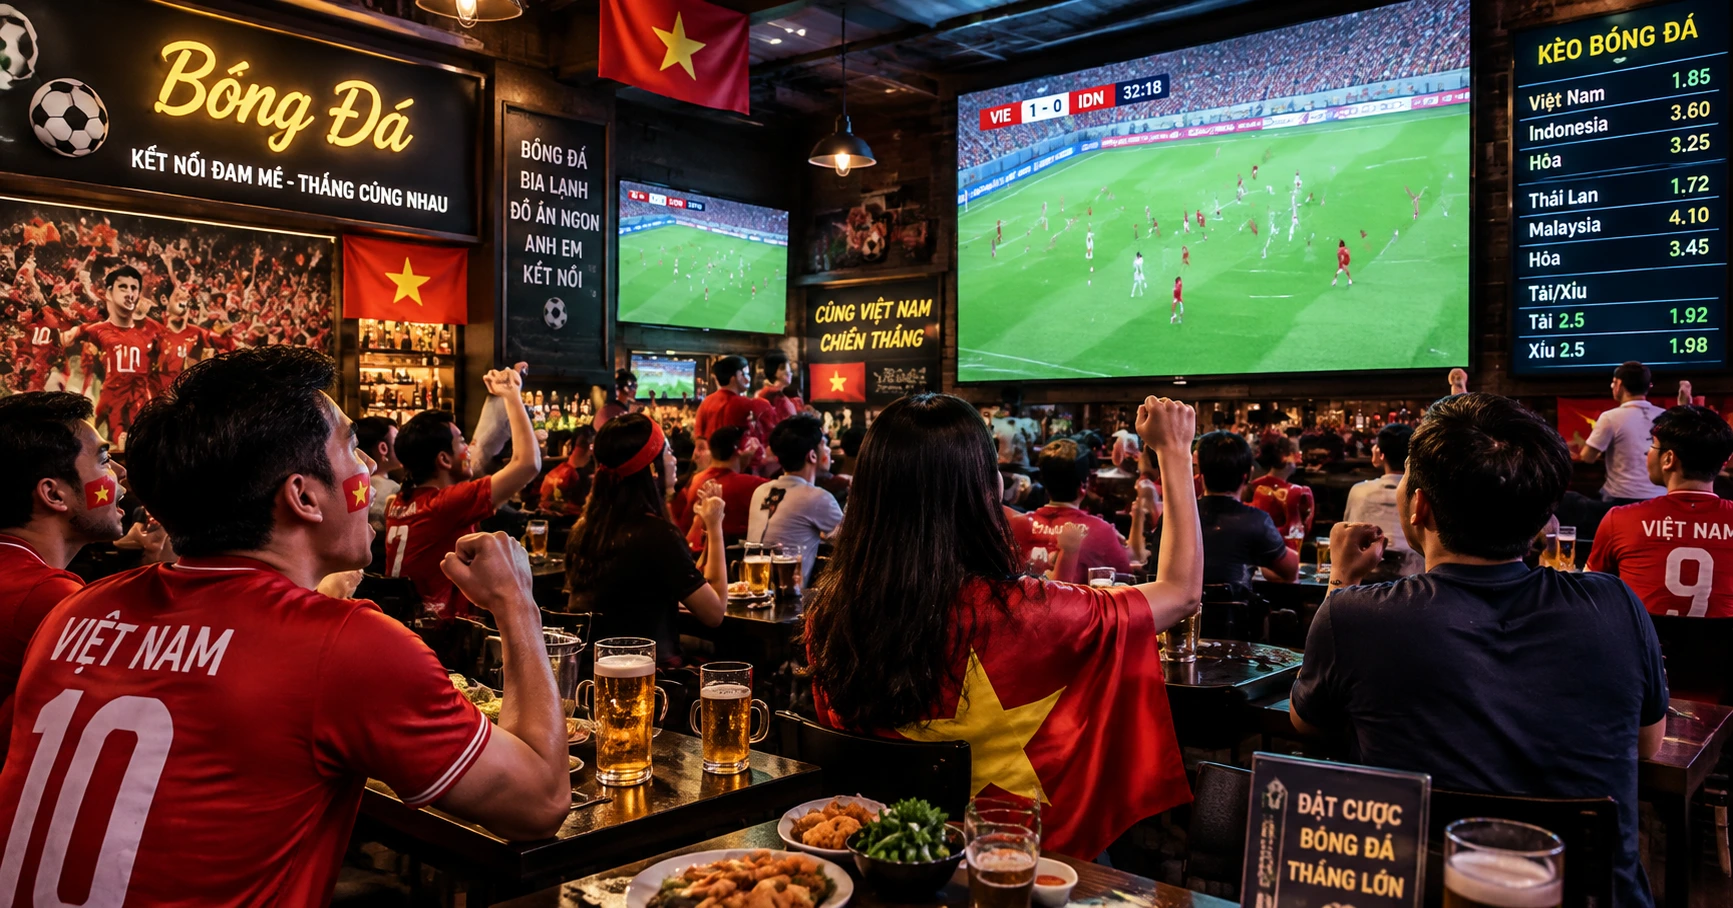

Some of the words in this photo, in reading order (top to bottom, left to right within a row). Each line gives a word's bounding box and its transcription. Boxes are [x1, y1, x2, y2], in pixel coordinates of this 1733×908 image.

[1538, 36, 1582, 65] KÈO
[1589, 26, 1655, 56] BÓNG
[1663, 12, 1698, 43] ĐÁ
[154, 40, 315, 152] Bóng
[327, 80, 414, 152] Đá
[990, 107, 1011, 124] VIE
[1029, 103, 1036, 117] 1
[1053, 99, 1062, 113] 0
[1078, 90, 1104, 109] IDN
[1123, 80, 1162, 100] 32:18
[1529, 92, 1562, 112] Việt
[1567, 88, 1605, 106] Nam
[1672, 68, 1710, 89] 1.85
[1529, 116, 1608, 141] Indonesia
[1671, 101, 1710, 121] 3.60
[567, 145, 588, 170] ĐÁ
[1670, 133, 1710, 153] 3.25
[211, 160, 253, 184] ĐAM
[406, 191, 448, 213] NHAU
[520, 170, 545, 192] BIA
[550, 175, 588, 200] LẠNH
[1528, 189, 1563, 209] Thái
[1568, 189, 1598, 205] Lan
[1671, 175, 1709, 195] 1.72
[561, 208, 600, 232] NGON
[1529, 216, 1601, 238] Malaysia
[1669, 206, 1710, 225] 4.10
[525, 233, 557, 255] ANH
[562, 239, 582, 259] EM
[1669, 238, 1709, 257] 3.45
[860, 296, 894, 326] VIỆT
[896, 298, 932, 318] NAM
[1559, 312, 1585, 329] 2.5
[1669, 306, 1708, 324] 1.92
[1560, 341, 1585, 358] 2.5
[1669, 337, 1708, 354] 1.98
[1641, 515, 1687, 541] VIỆT
[1665, 547, 1714, 618] 9
[50, 610, 139, 675] VIỆT
[128, 625, 235, 676] NAM
[0, 688, 174, 908] 10
[1342, 799, 1403, 830] CƯỢC
